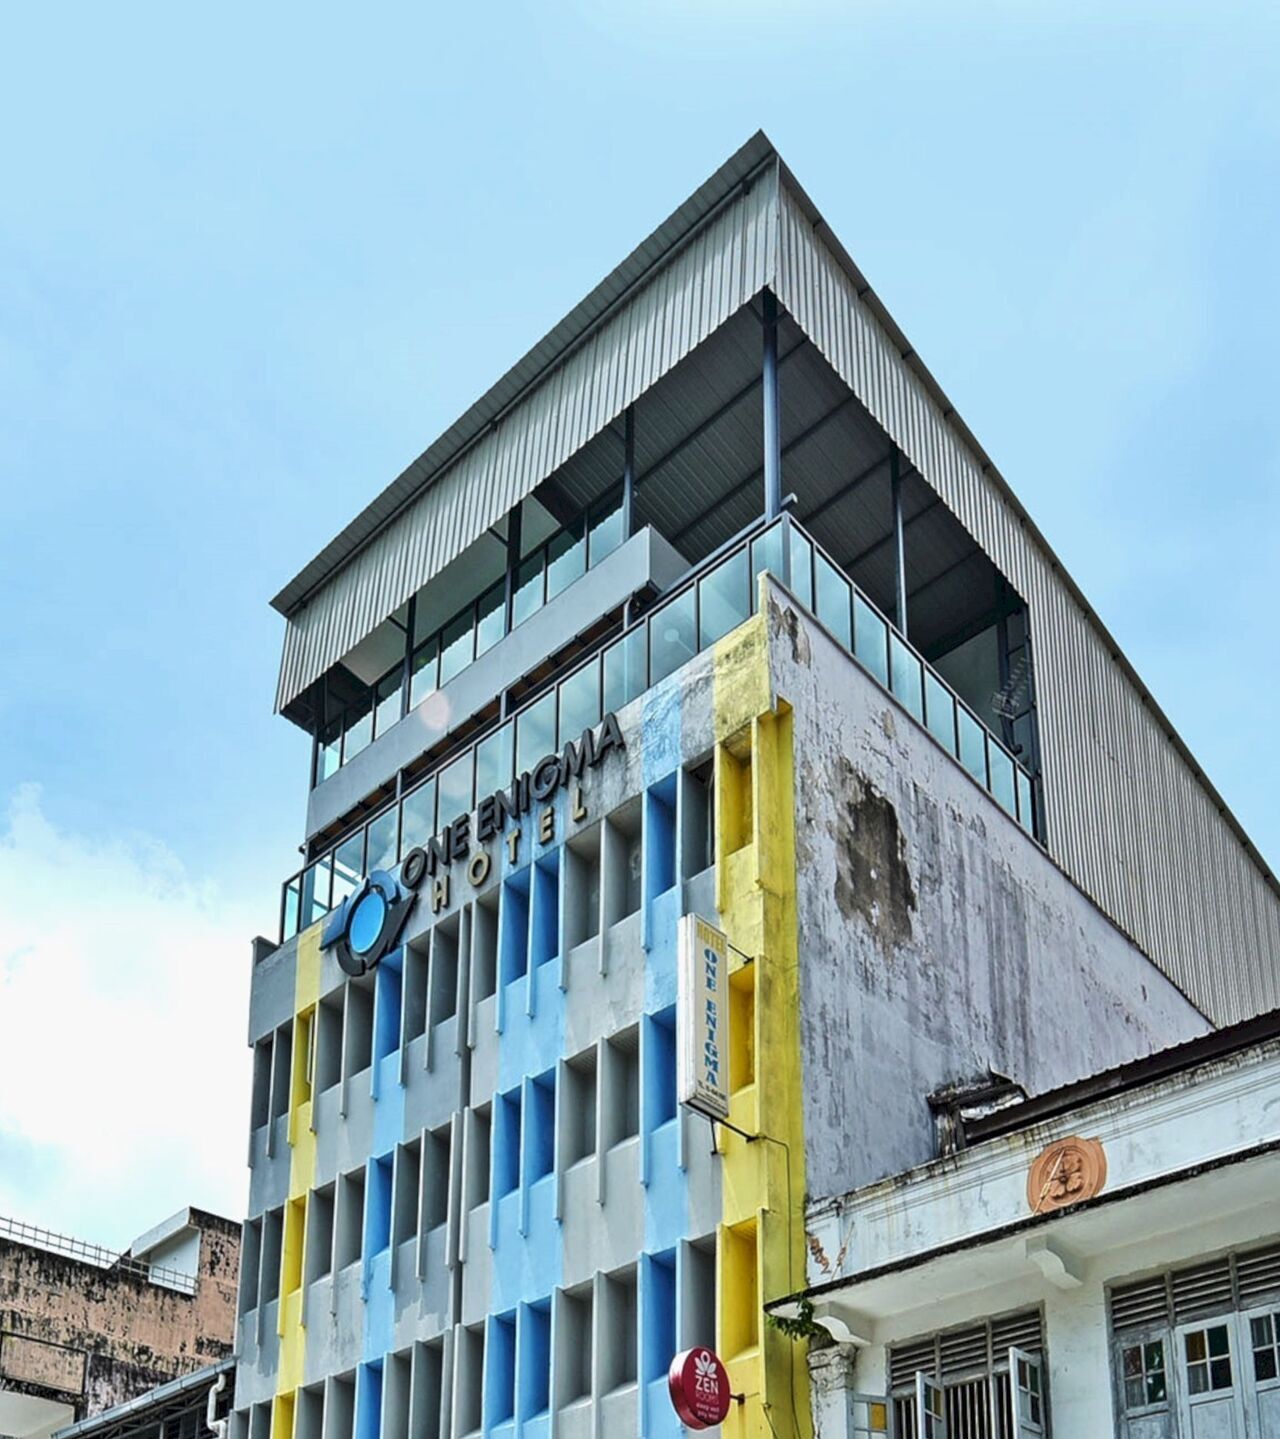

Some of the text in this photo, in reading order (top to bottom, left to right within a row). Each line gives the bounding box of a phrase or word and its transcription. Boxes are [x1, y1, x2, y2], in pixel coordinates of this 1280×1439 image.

[401, 712, 626, 889] ONE ENIGMA
[432, 786, 586, 914] HOTEL
[697, 922, 727, 955] HOTEL
[704, 948, 717, 992] ONE
[704, 999, 719, 1087] ENIGMA
[695, 1375, 719, 1394] ZEN
